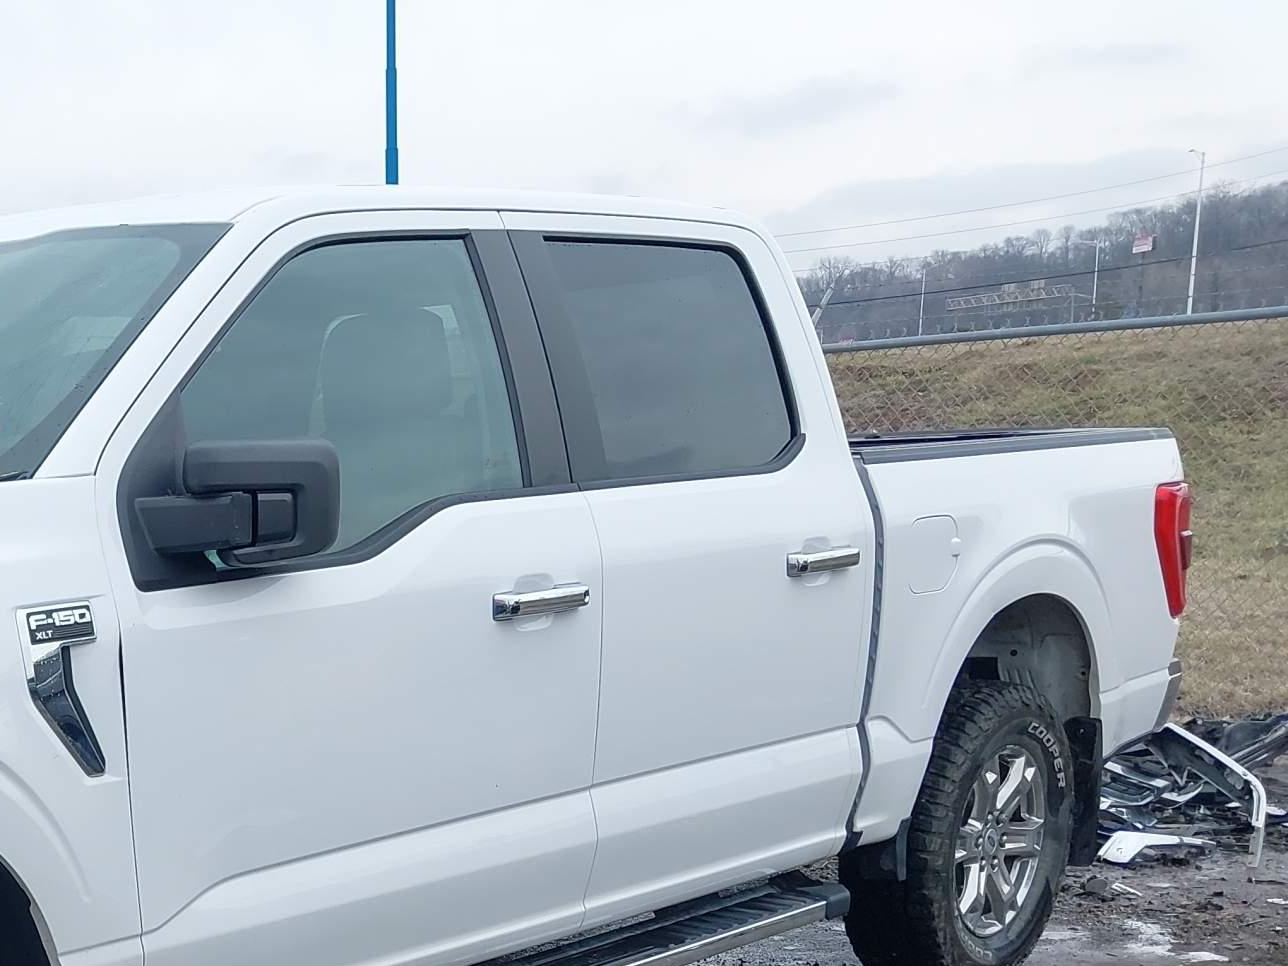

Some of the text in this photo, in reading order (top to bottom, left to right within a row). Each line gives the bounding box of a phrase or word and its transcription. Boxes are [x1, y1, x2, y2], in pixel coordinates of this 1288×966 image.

[29, 608, 92, 630] F-150
[35, 630, 54, 641] XLT
[1027, 722, 1066, 789] COOPER
